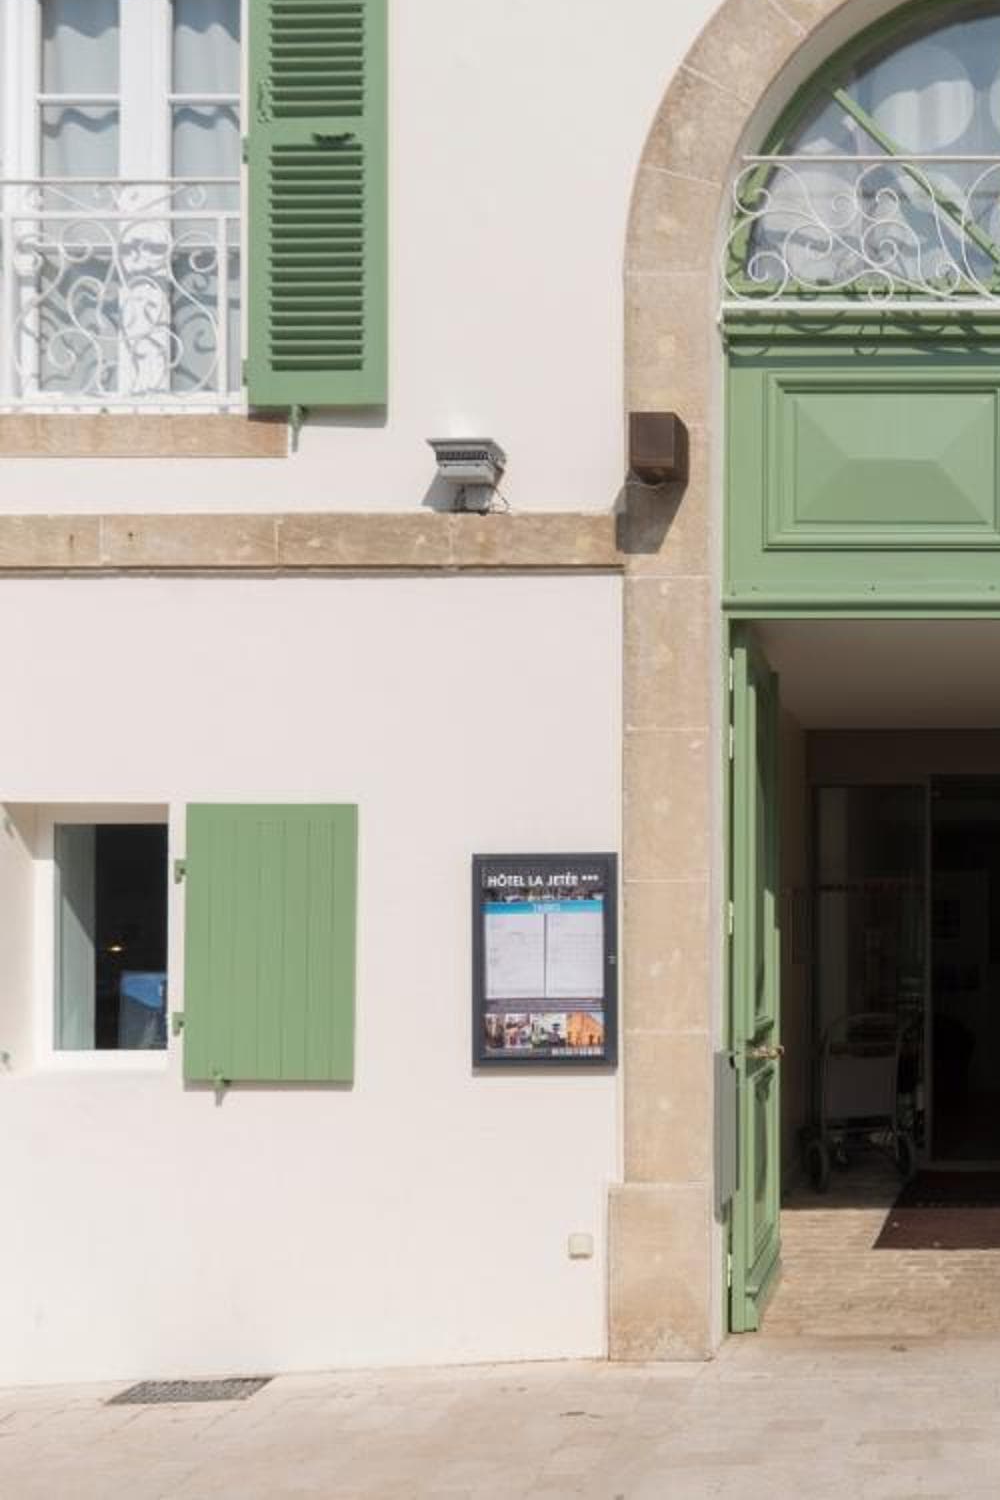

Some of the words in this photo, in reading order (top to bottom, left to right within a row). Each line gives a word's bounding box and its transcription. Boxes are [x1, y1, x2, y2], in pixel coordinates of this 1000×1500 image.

[487, 873, 526, 887] HÔTEL
[528, 875, 543, 887] LA
[547, 872, 578, 886] JETÉE
